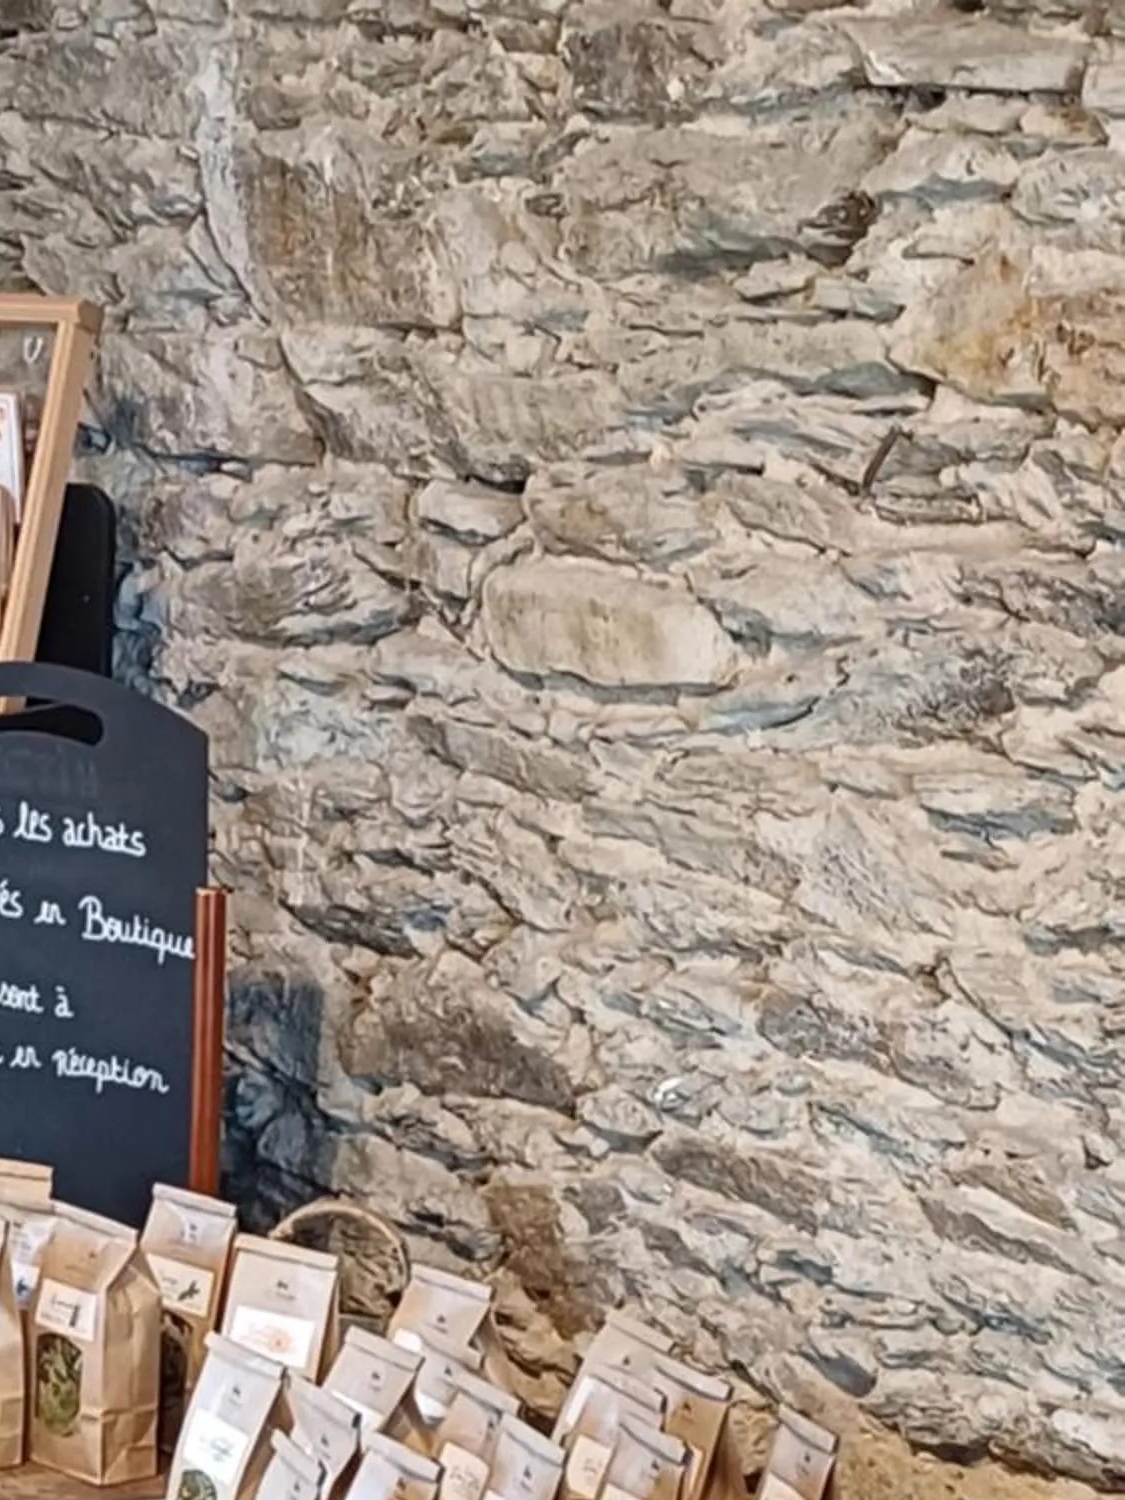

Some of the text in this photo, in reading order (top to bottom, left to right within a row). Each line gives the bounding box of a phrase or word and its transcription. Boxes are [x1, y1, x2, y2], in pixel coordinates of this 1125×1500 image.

[13, 801, 53, 843] les
[62, 812, 146, 857] achats
[34, 901, 66, 925] en
[78, 896, 196, 965] Boutique
[54, 986, 74, 1018] à
[10, 1046, 41, 1068] en
